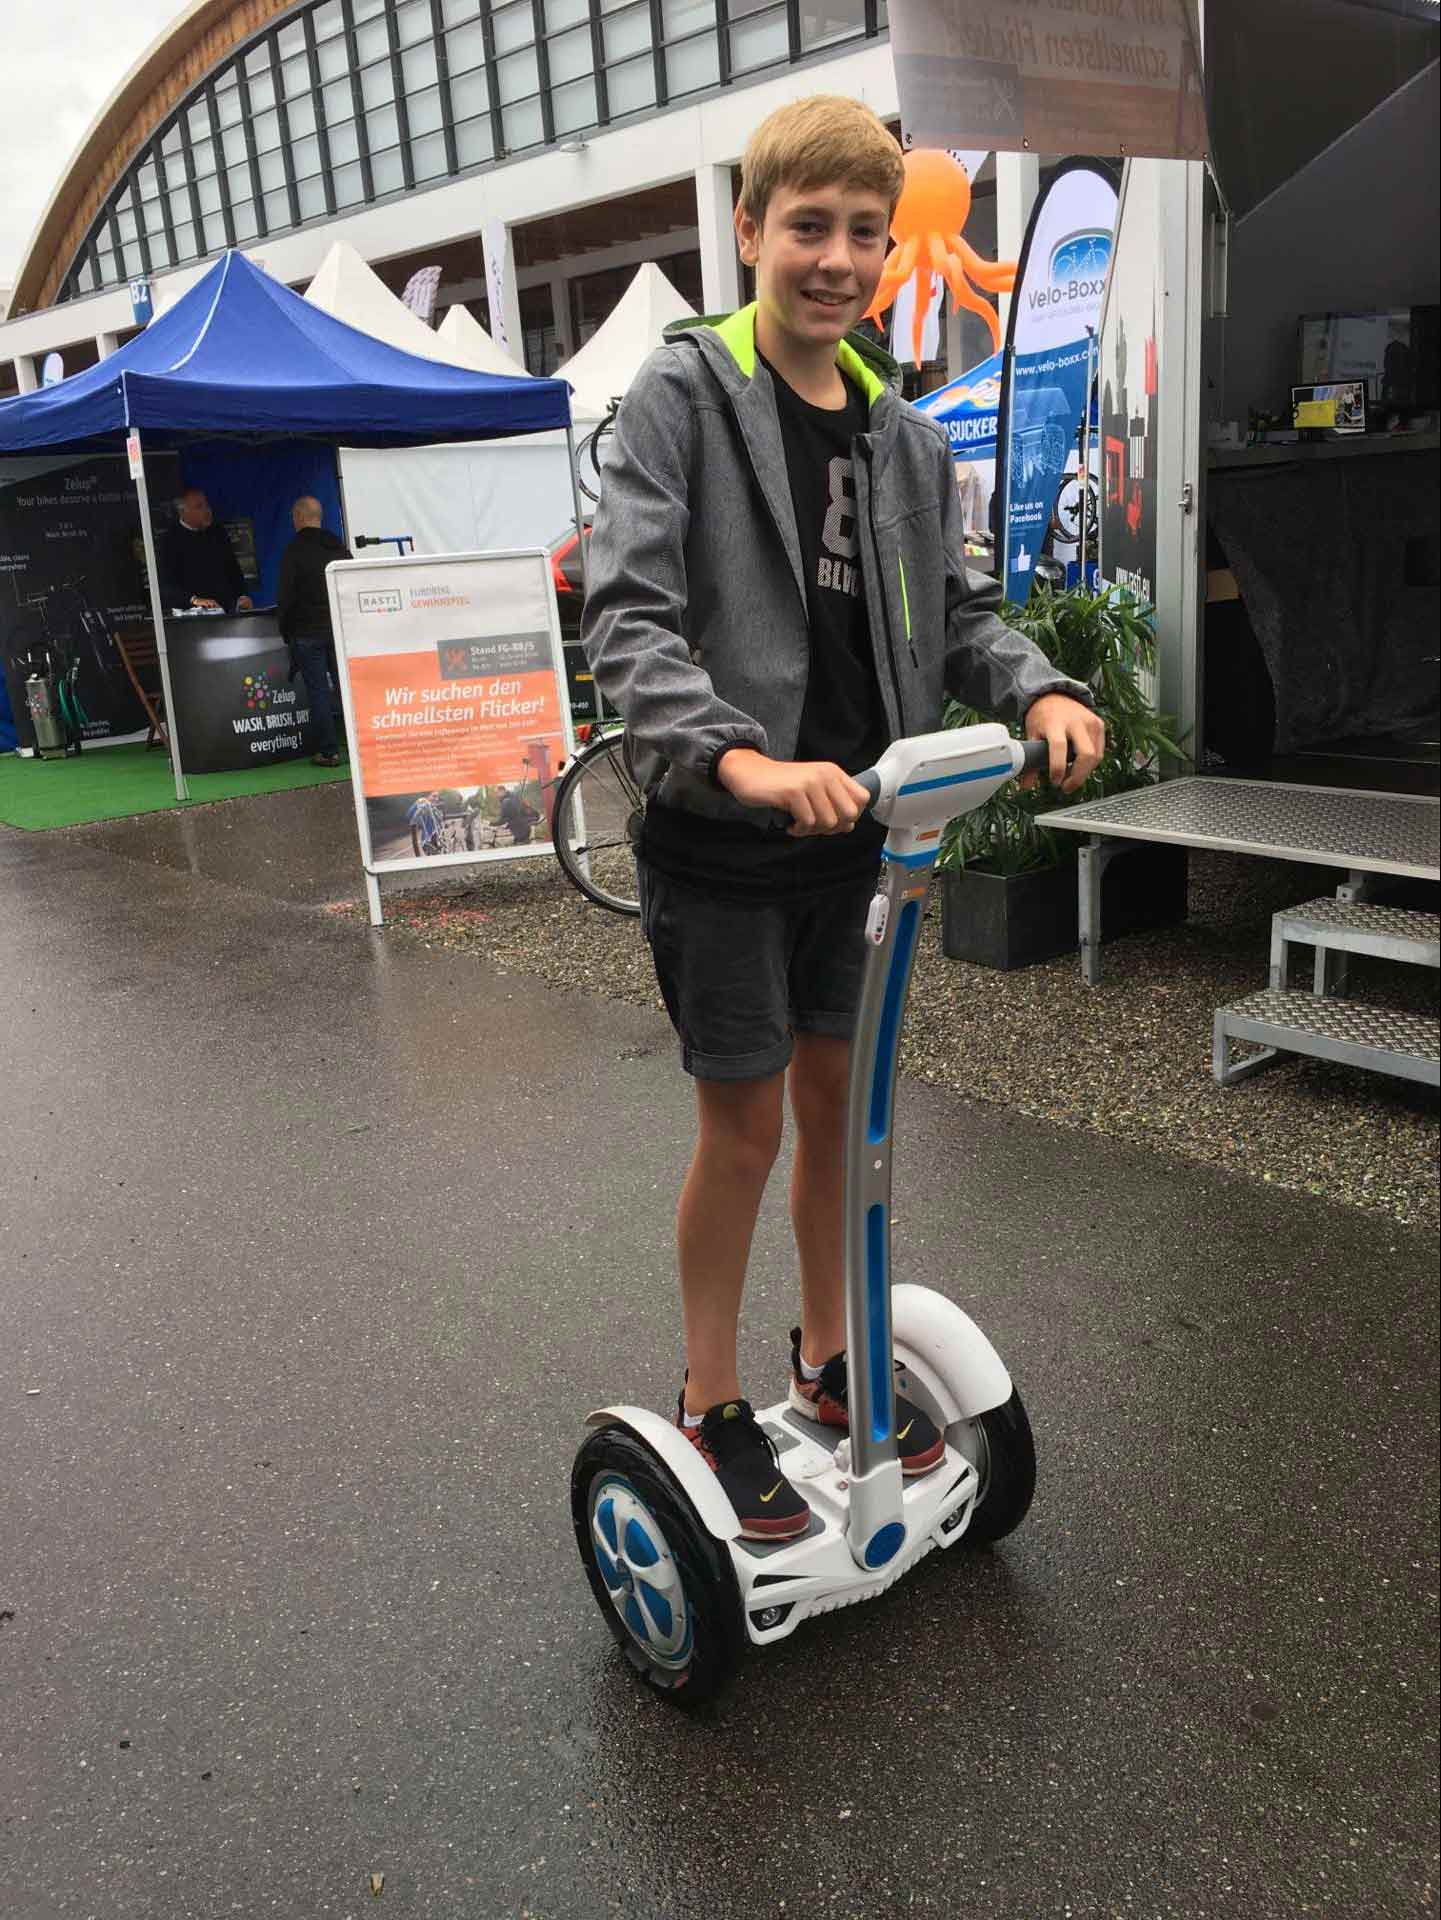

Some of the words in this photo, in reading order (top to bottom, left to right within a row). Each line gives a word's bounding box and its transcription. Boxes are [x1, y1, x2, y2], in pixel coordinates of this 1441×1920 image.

[272, 688, 296, 705] Zelup
[385, 687, 417, 706] Wir
[421, 682, 483, 704] suchen
[489, 679, 522, 697] den
[232, 715, 266, 734] WASH,
[266, 711, 296, 730] BRUSH,
[373, 704, 474, 729] schnellsten
[480, 696, 546, 719] Flicker!
